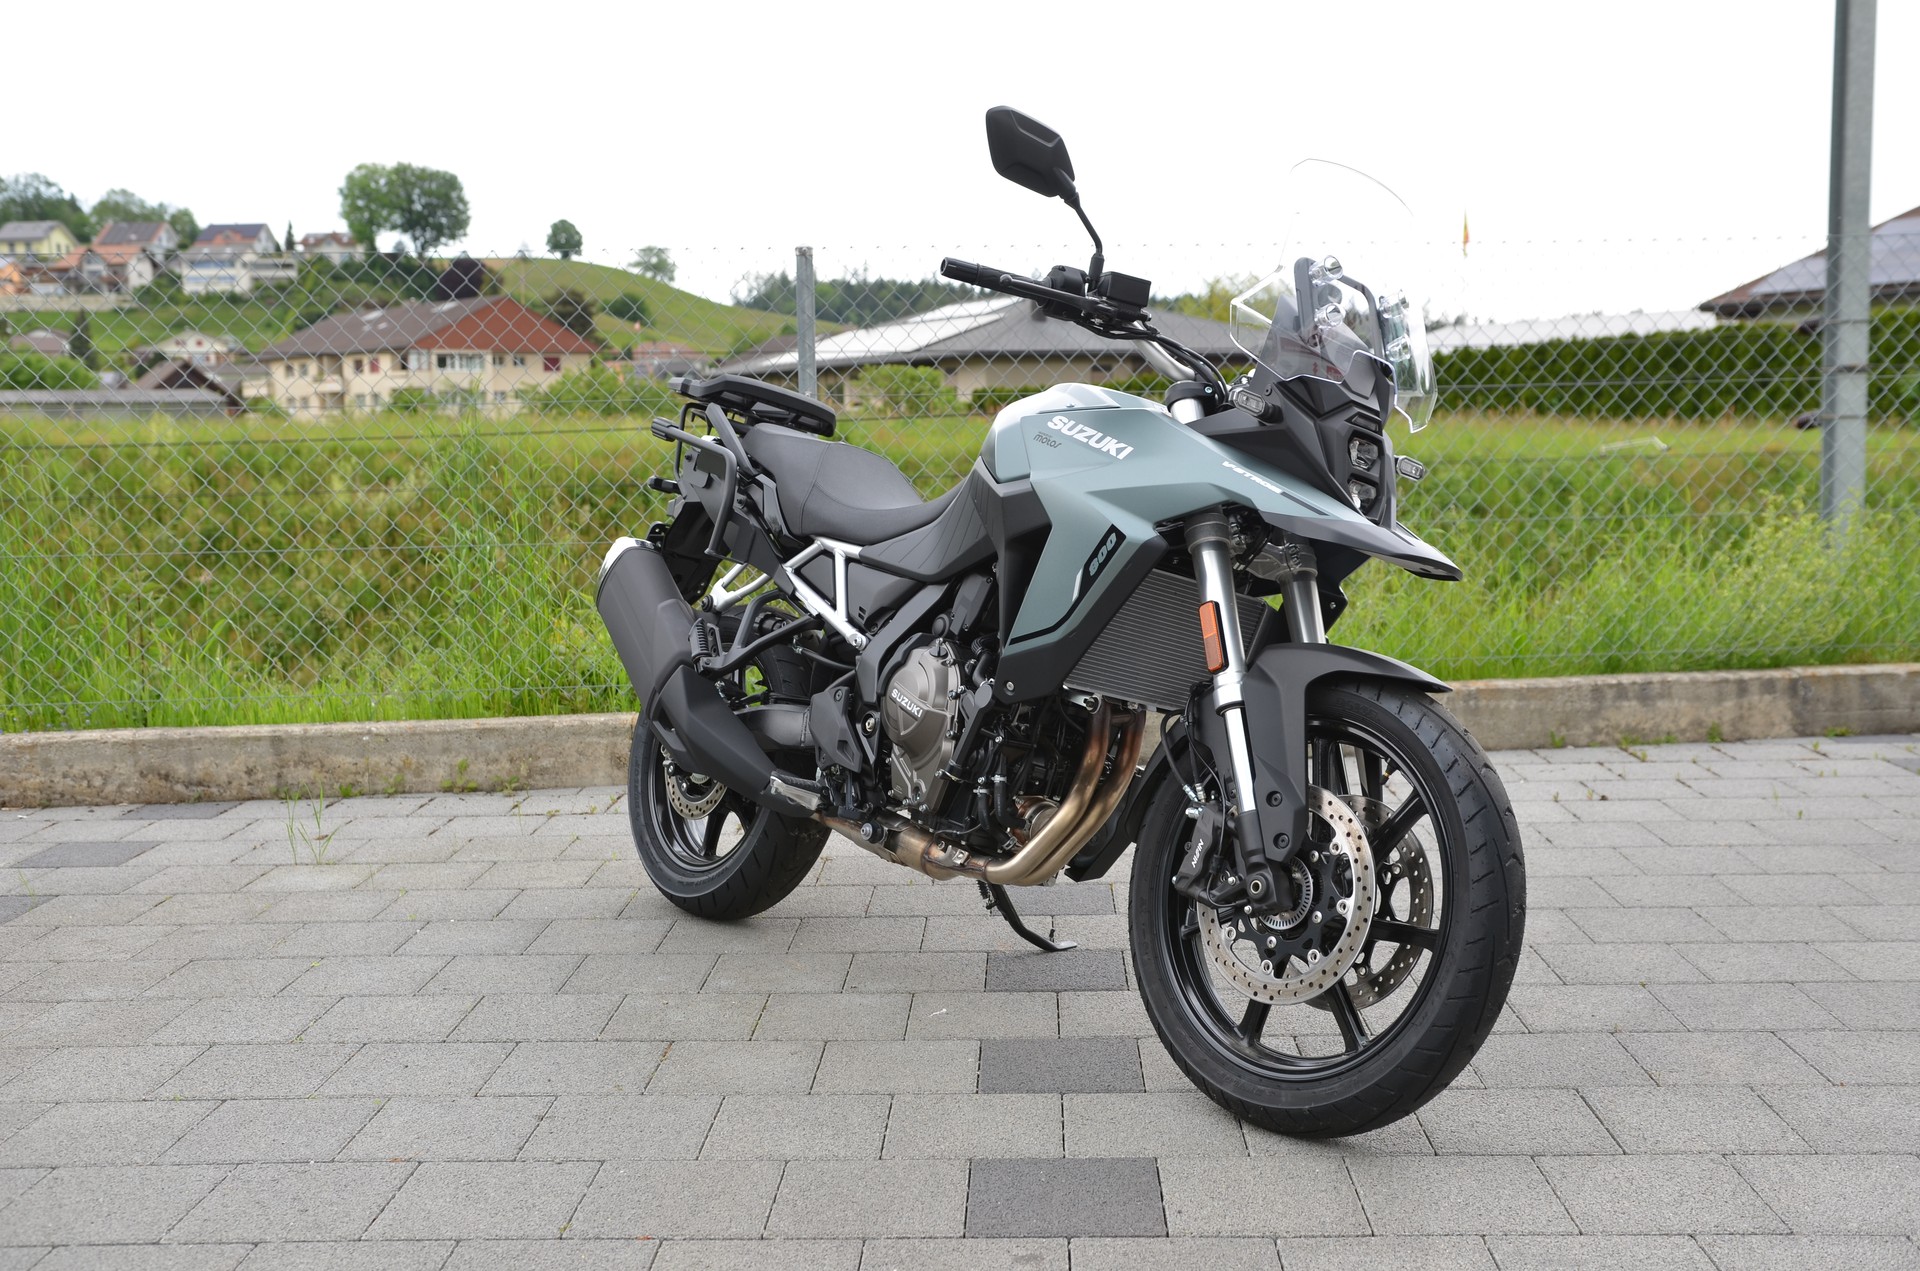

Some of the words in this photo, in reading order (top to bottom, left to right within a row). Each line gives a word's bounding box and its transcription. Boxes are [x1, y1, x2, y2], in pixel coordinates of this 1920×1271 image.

[1047, 415, 1134, 460] SUZUKI
[1089, 532, 1117, 577] 800
[891, 688, 923, 718] SUZUKI
